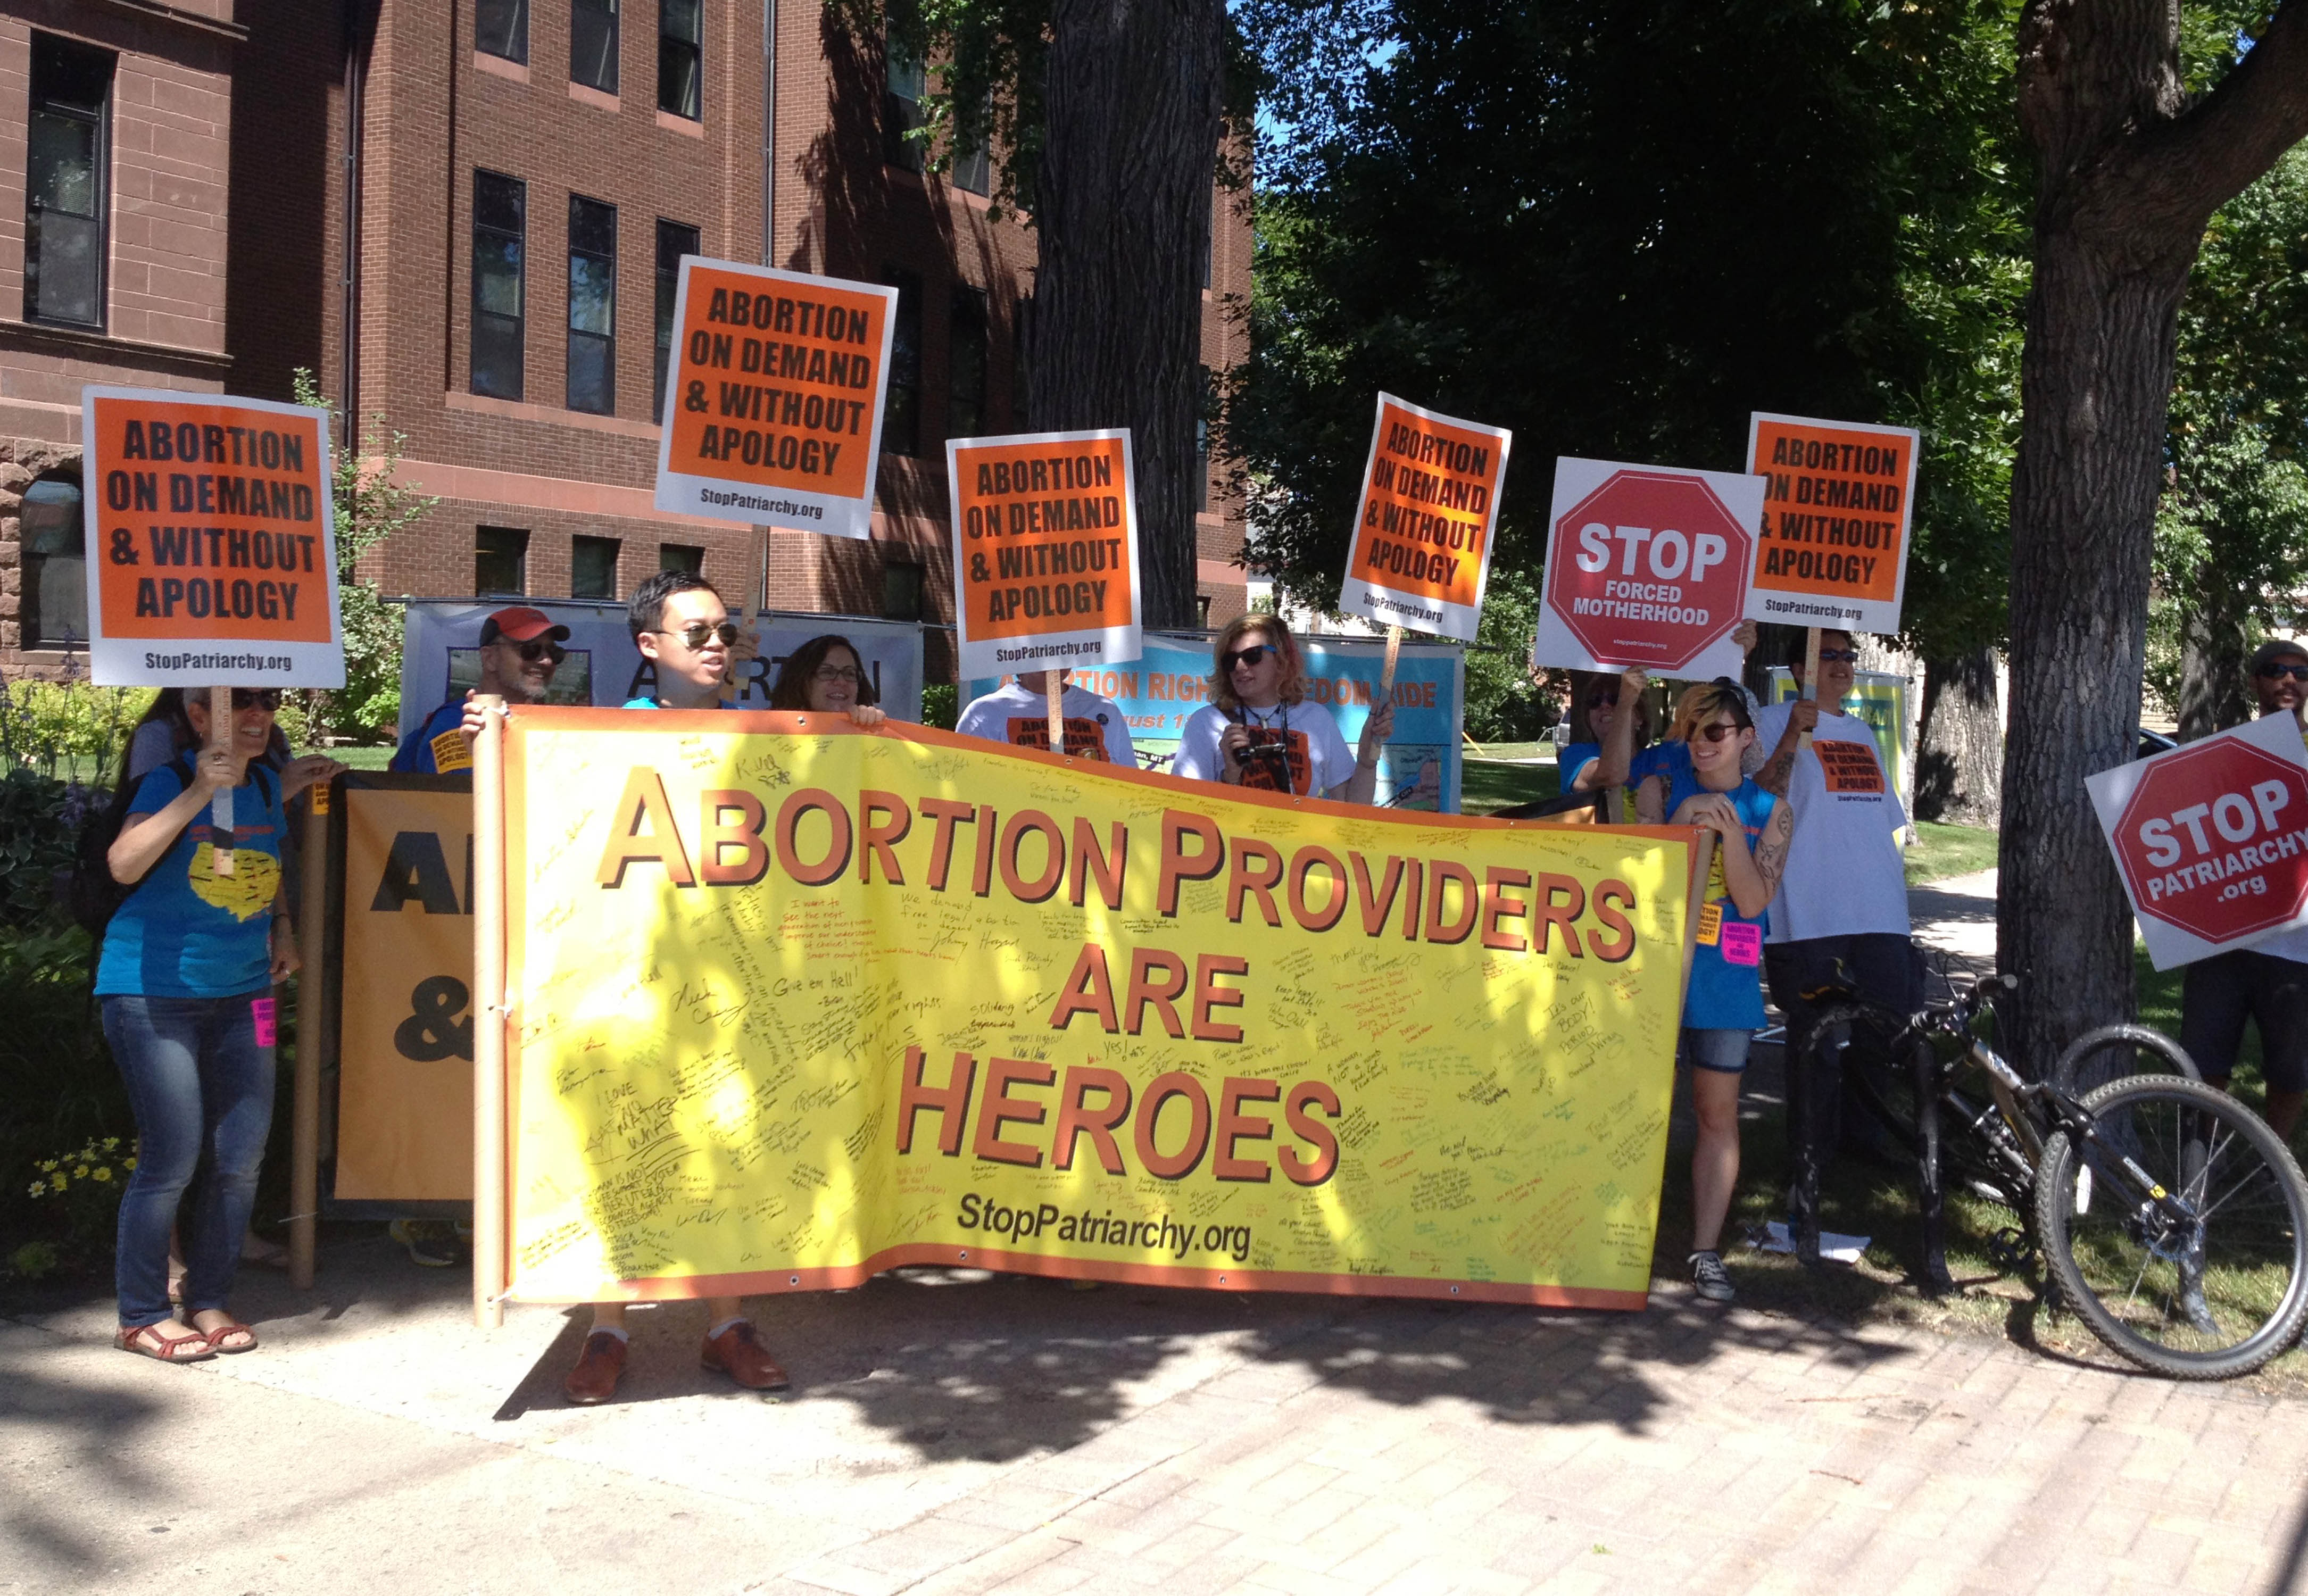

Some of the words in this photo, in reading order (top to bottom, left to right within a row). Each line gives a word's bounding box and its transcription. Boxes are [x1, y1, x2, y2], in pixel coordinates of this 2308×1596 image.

[708, 287, 868, 345] ABORTION
[690, 329, 733, 370] ON
[741, 337, 871, 390] DEMAND
[685, 379, 709, 414] &
[720, 380, 866, 436] WITHOUT
[123, 419, 303, 472] ABORTION
[699, 424, 841, 476] APOLOGY
[1387, 422, 1489, 477] ABORTION
[1772, 437, 1897, 477] ABORTION
[107, 470, 157, 512] ON
[169, 473, 313, 522] DEMAND
[977, 454, 1111, 497] ABORTION
[1374, 456, 1396, 492] ON
[1397, 466, 1487, 515] DEMAND
[1762, 471, 1790, 503] ON
[1796, 476, 1899, 514] DEMAND
[701, 488, 823, 520] StopPatriarchy.org
[967, 504, 1001, 540] ON
[1009, 496, 1120, 536] DEMAND
[1366, 499, 1378, 528] &
[1383, 504, 1481, 553] WITHOUT
[110, 528, 139, 566] &
[150, 526, 314, 572] WITHOUT
[1576, 522, 1727, 583] STOP
[1759, 512, 1773, 538] &
[1780, 511, 1896, 551] WITHOUT
[970, 552, 991, 584] &
[997, 538, 1122, 580] WITHOUT
[1367, 537, 1460, 587] APOLOGY
[1764, 547, 1877, 585] APOLOGY
[136, 577, 298, 621] APOLOGY
[989, 580, 1107, 623] APOLOGY
[1363, 592, 1443, 624] StopPatriarchy.org
[1573, 597, 1709, 627] MOTHERHOOD
[1605, 580, 1682, 603] FORCED
[1765, 598, 1862, 621] StopPatriarchy.org
[146, 652, 292, 671] StopPatriarchy.org
[997, 641, 1101, 663] StopPatriarchy.org
[1613, 638, 1667, 650] stoppatriarchy.org
[1148, 672, 1210, 702] RIGH
[1837, 777, 1878, 789] APOLOGY
[2139, 779, 2289, 868] STOP
[595, 765, 1128, 912] ABORTION
[1156, 807, 1637, 963] PROVIDERS
[2146, 827, 2308, 901] PATRIARCHY
[902, 894, 920, 903] We
[2217, 875, 2267, 902] .org
[940, 910, 968, 923] legal
[1047, 942, 1249, 1043] ARE
[394, 975, 474, 1062] &
[895, 1045, 1341, 1187] HEROES
[957, 1192, 1251, 1262] StopPatriarchy.org
